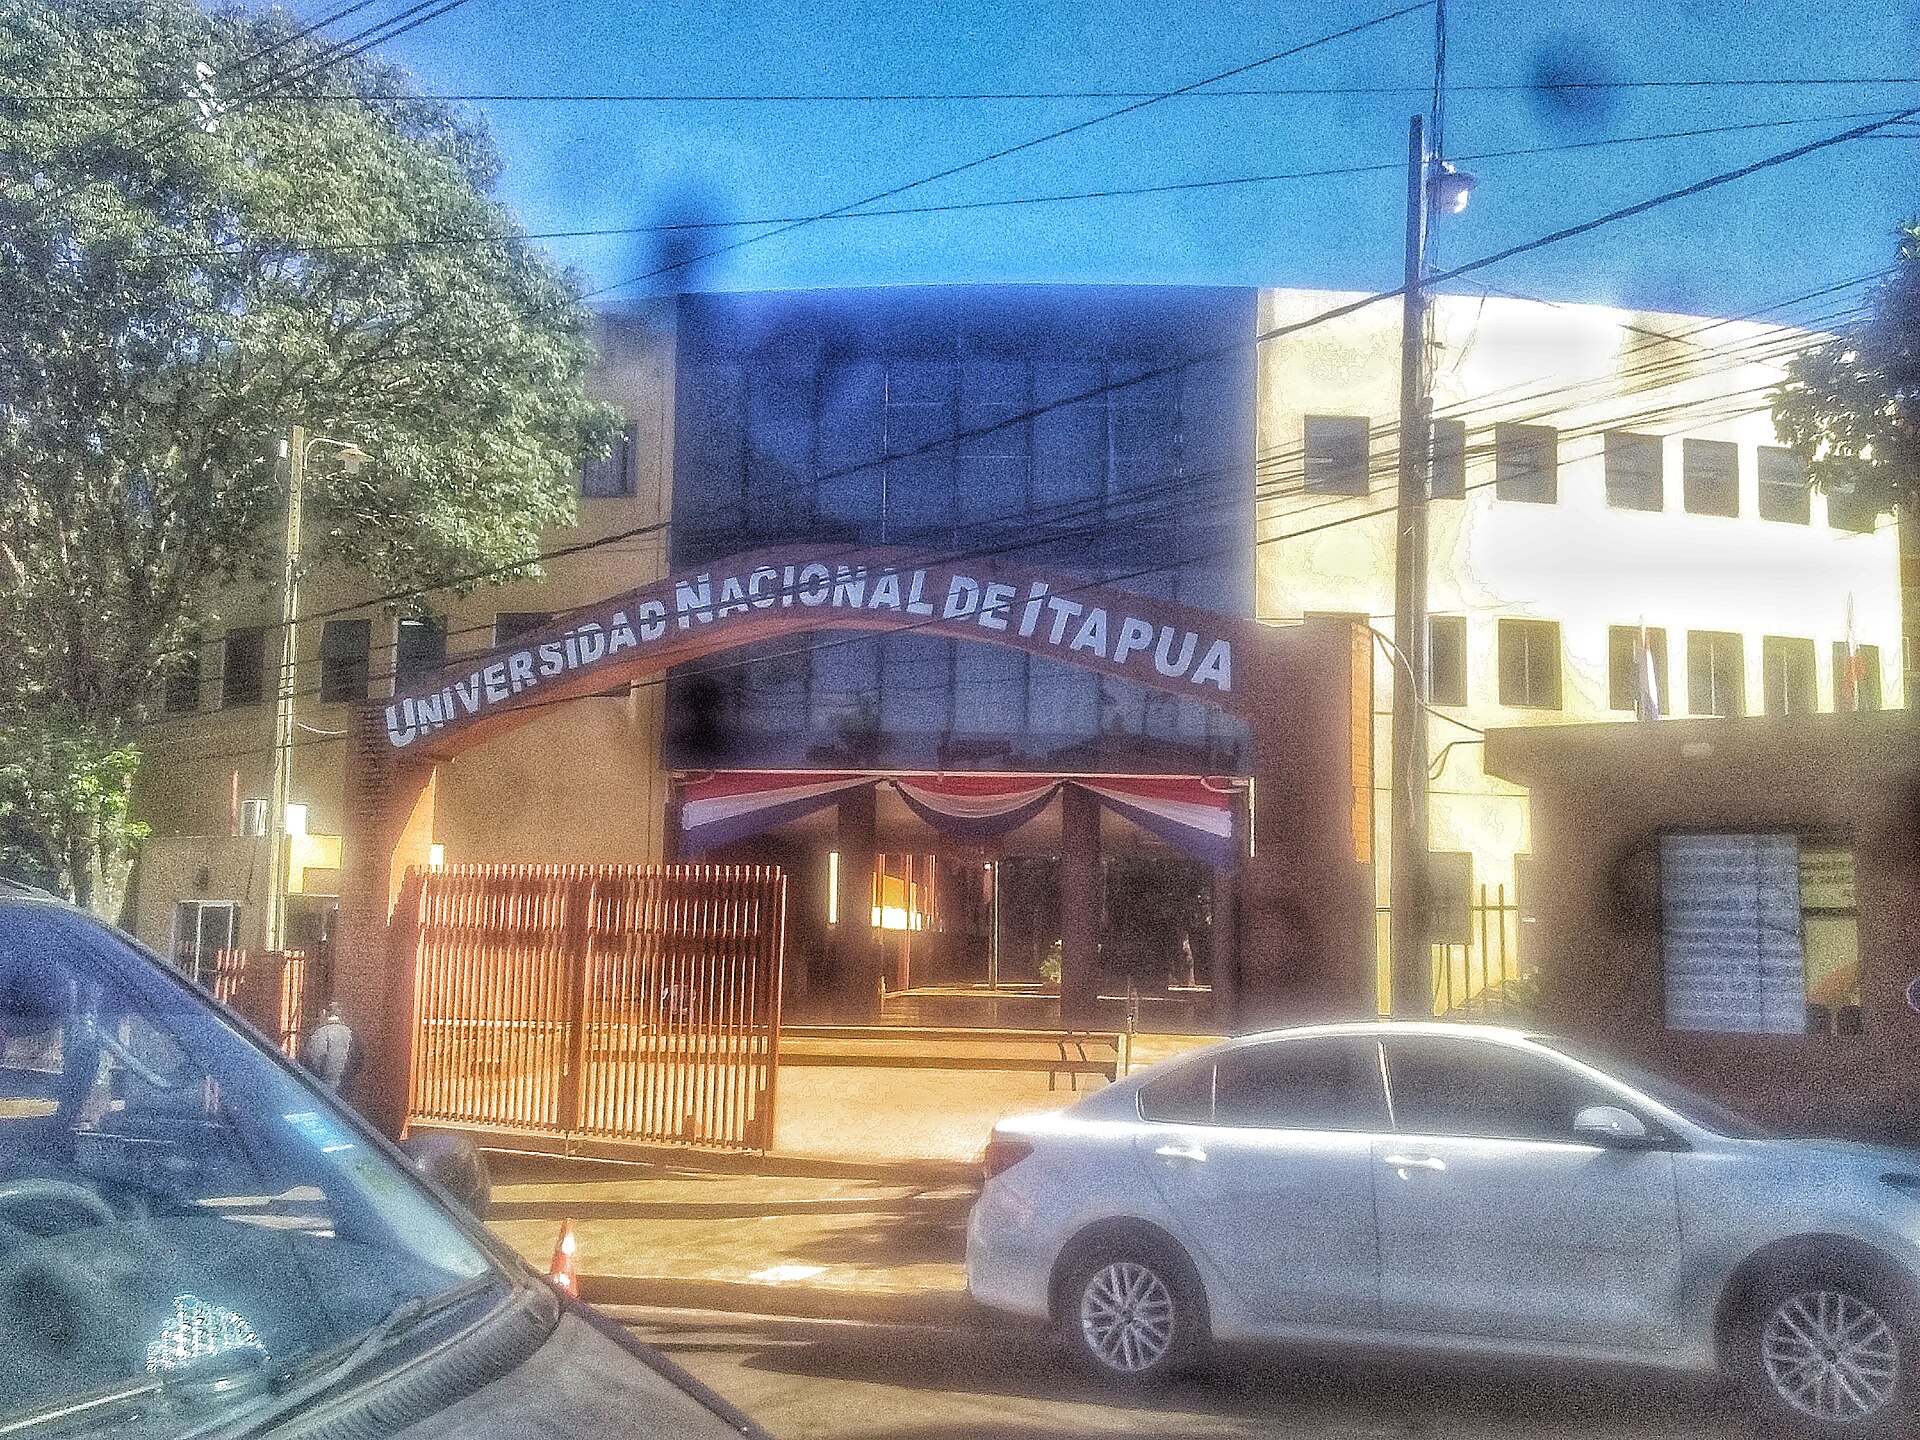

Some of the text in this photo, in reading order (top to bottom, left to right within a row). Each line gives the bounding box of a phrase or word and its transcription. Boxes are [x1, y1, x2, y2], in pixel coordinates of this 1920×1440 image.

[385, 563, 1233, 747] UNIVERSIDAD NACIONAL DE ITAPUA
